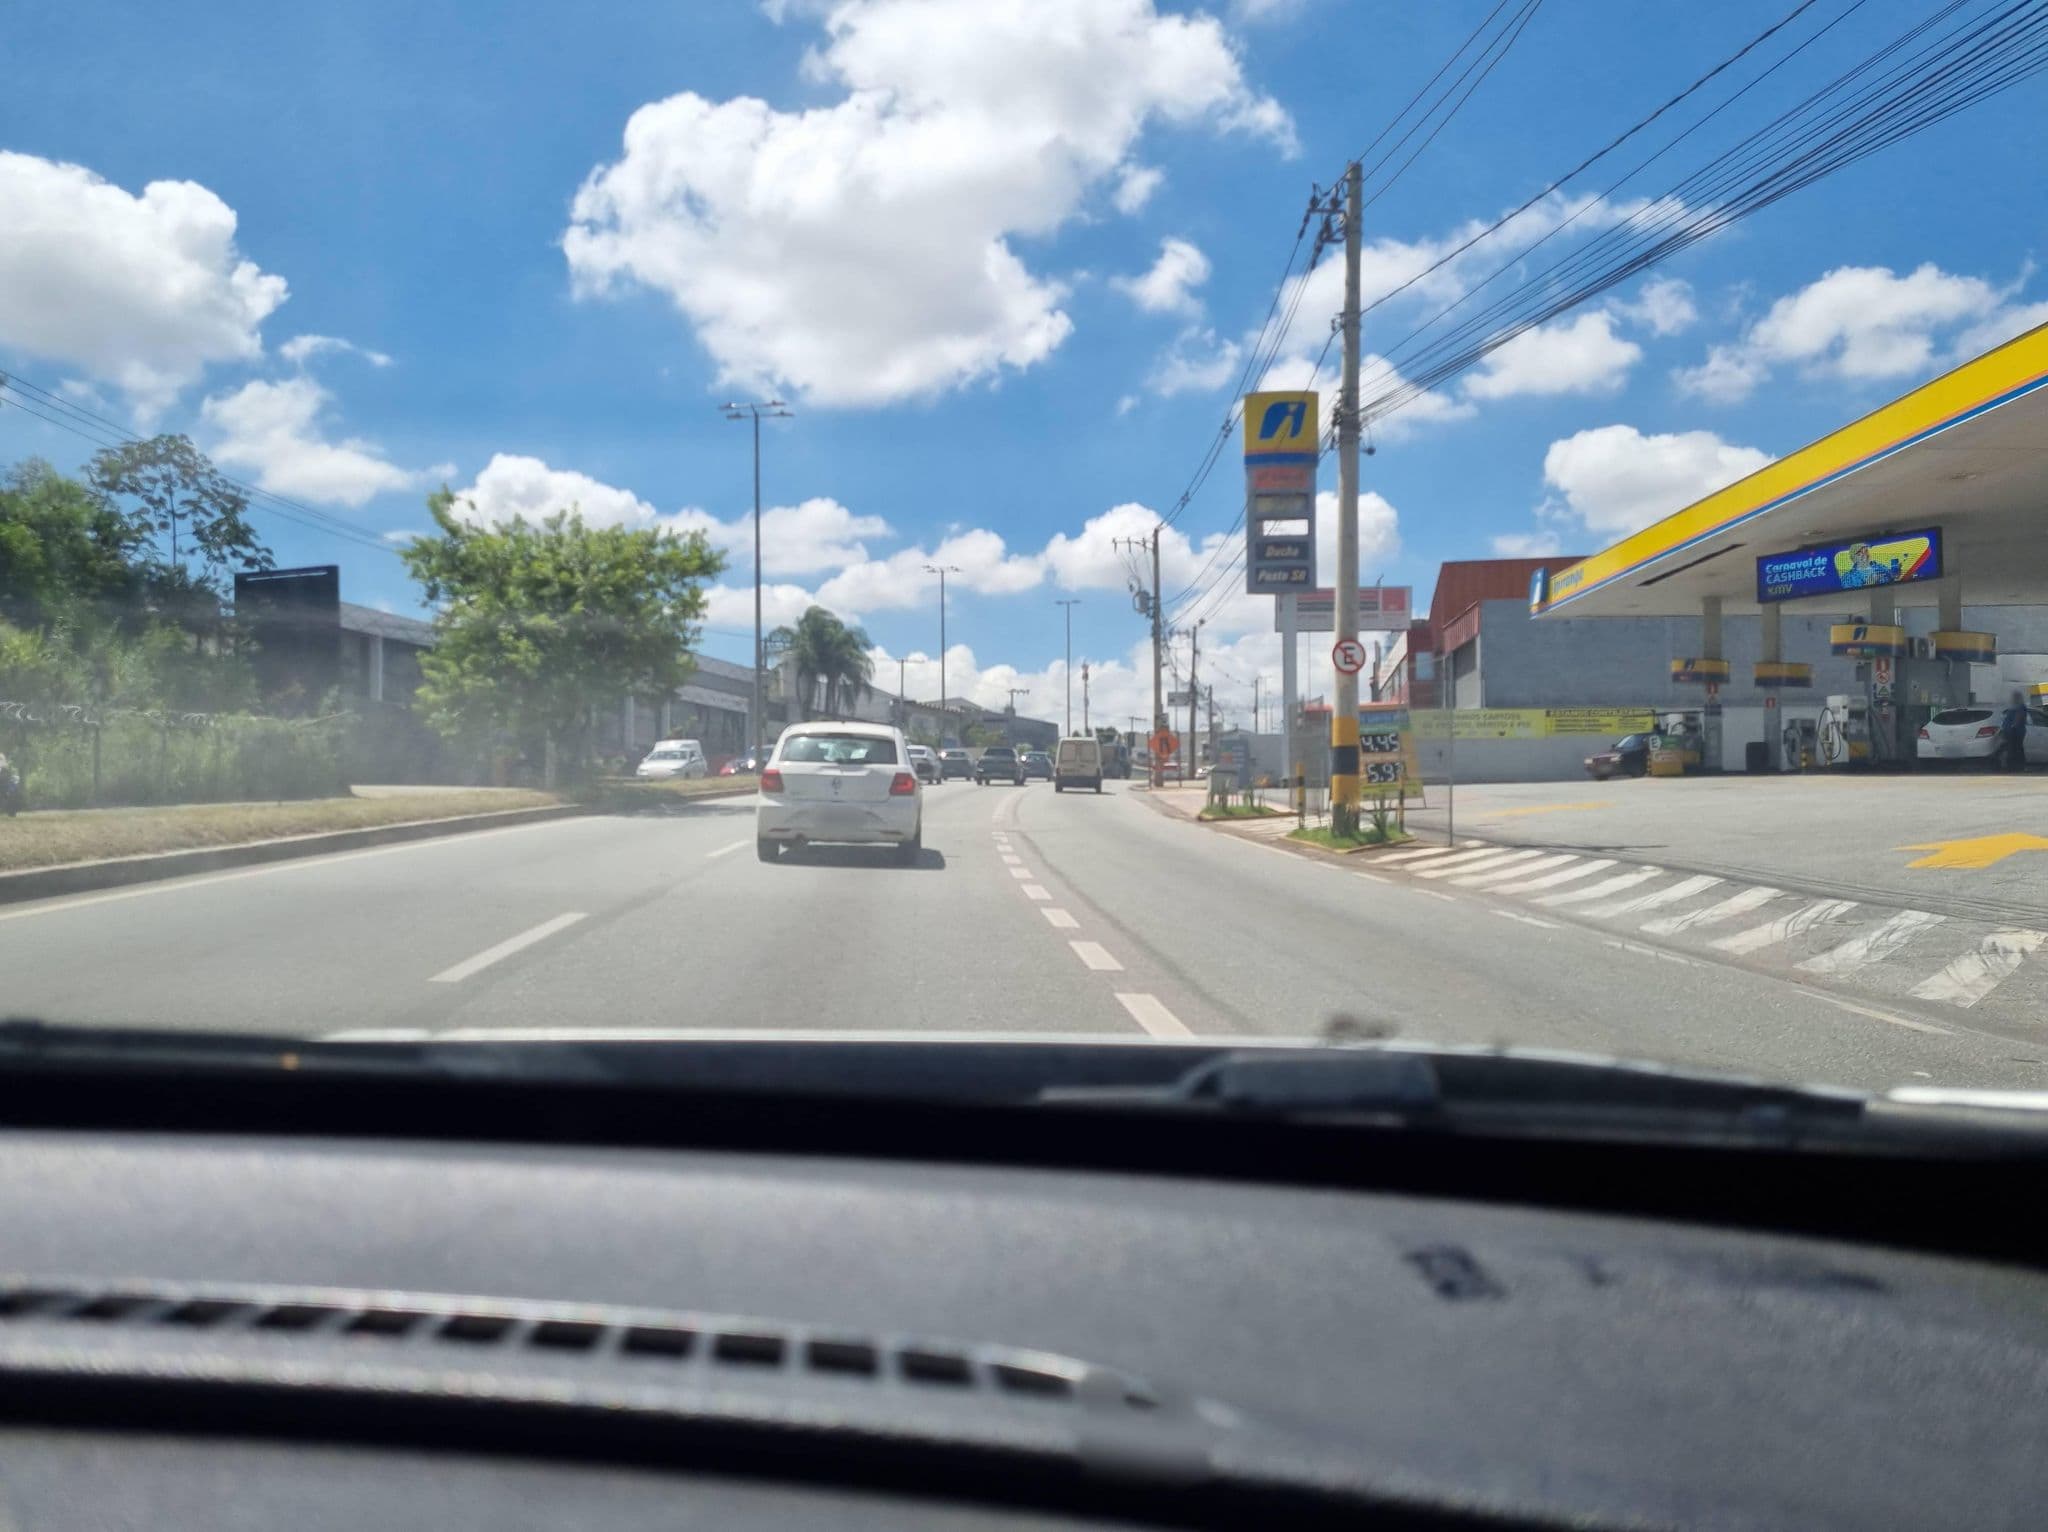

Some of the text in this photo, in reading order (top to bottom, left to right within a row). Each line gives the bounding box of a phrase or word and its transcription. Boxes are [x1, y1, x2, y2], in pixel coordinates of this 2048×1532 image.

[1765, 556, 1828, 574] Carnaval de
[1766, 566, 1826, 584] CASHBACK
[1343, 645, 1356, 665] E
